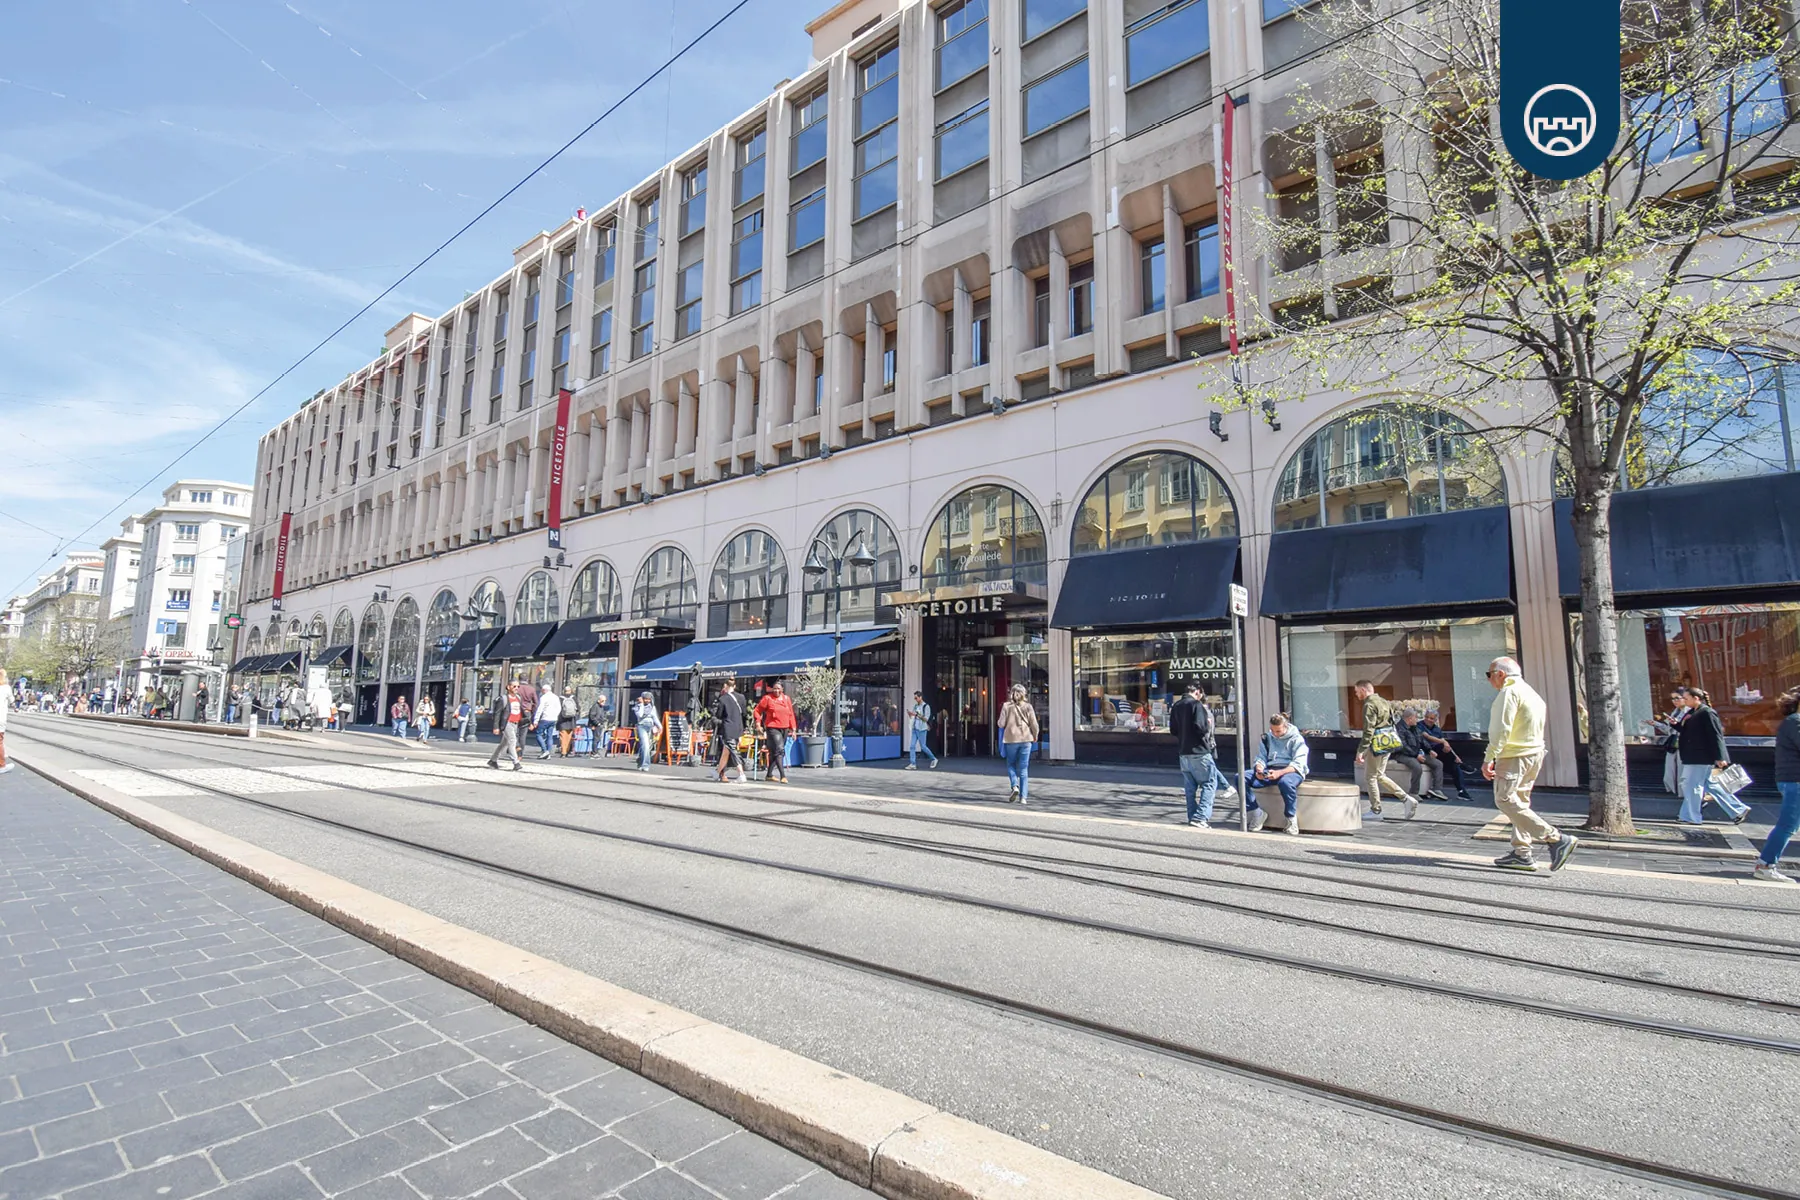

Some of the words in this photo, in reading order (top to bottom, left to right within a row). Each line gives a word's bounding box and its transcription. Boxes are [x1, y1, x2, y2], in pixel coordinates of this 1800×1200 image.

[553, 425, 565, 484] NICETOILE
[277, 535, 286, 572] NICETOILE
[960, 551, 1001, 564] Droulède
[895, 596, 1003, 619] NICETOILE
[598, 628, 655, 643] NICETOILE
[1169, 656, 1235, 669] MAISONS
[343, 668, 350, 677] P
